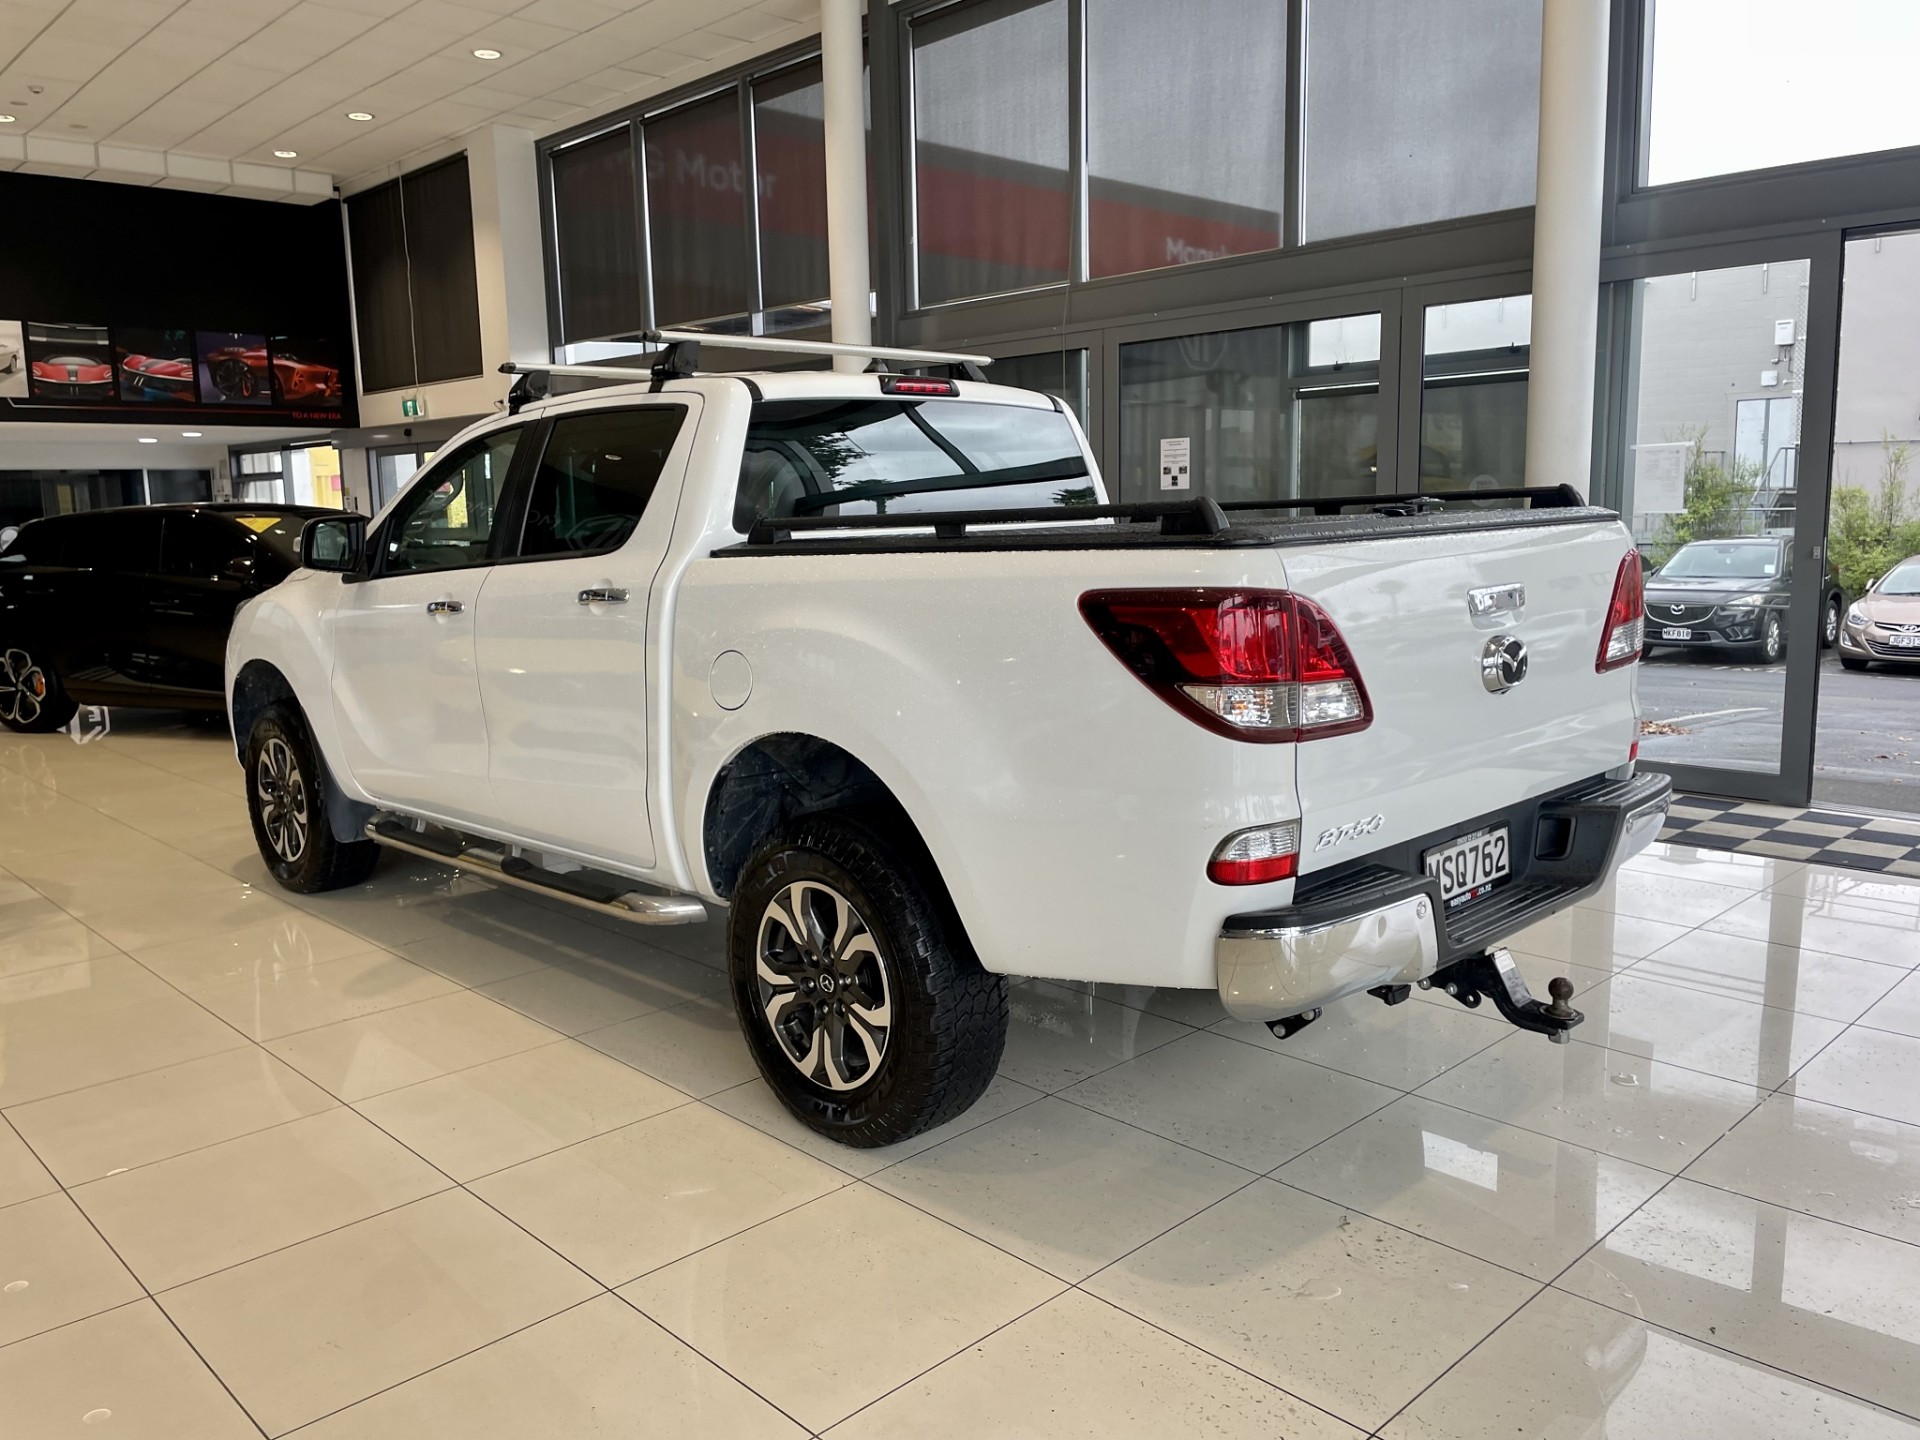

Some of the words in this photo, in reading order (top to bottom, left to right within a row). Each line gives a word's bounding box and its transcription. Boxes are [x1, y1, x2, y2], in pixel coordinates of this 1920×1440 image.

[675, 148, 776, 199] Motr
[1314, 814, 1385, 852] BT-50
[1428, 835, 1506, 894] MSQ762
